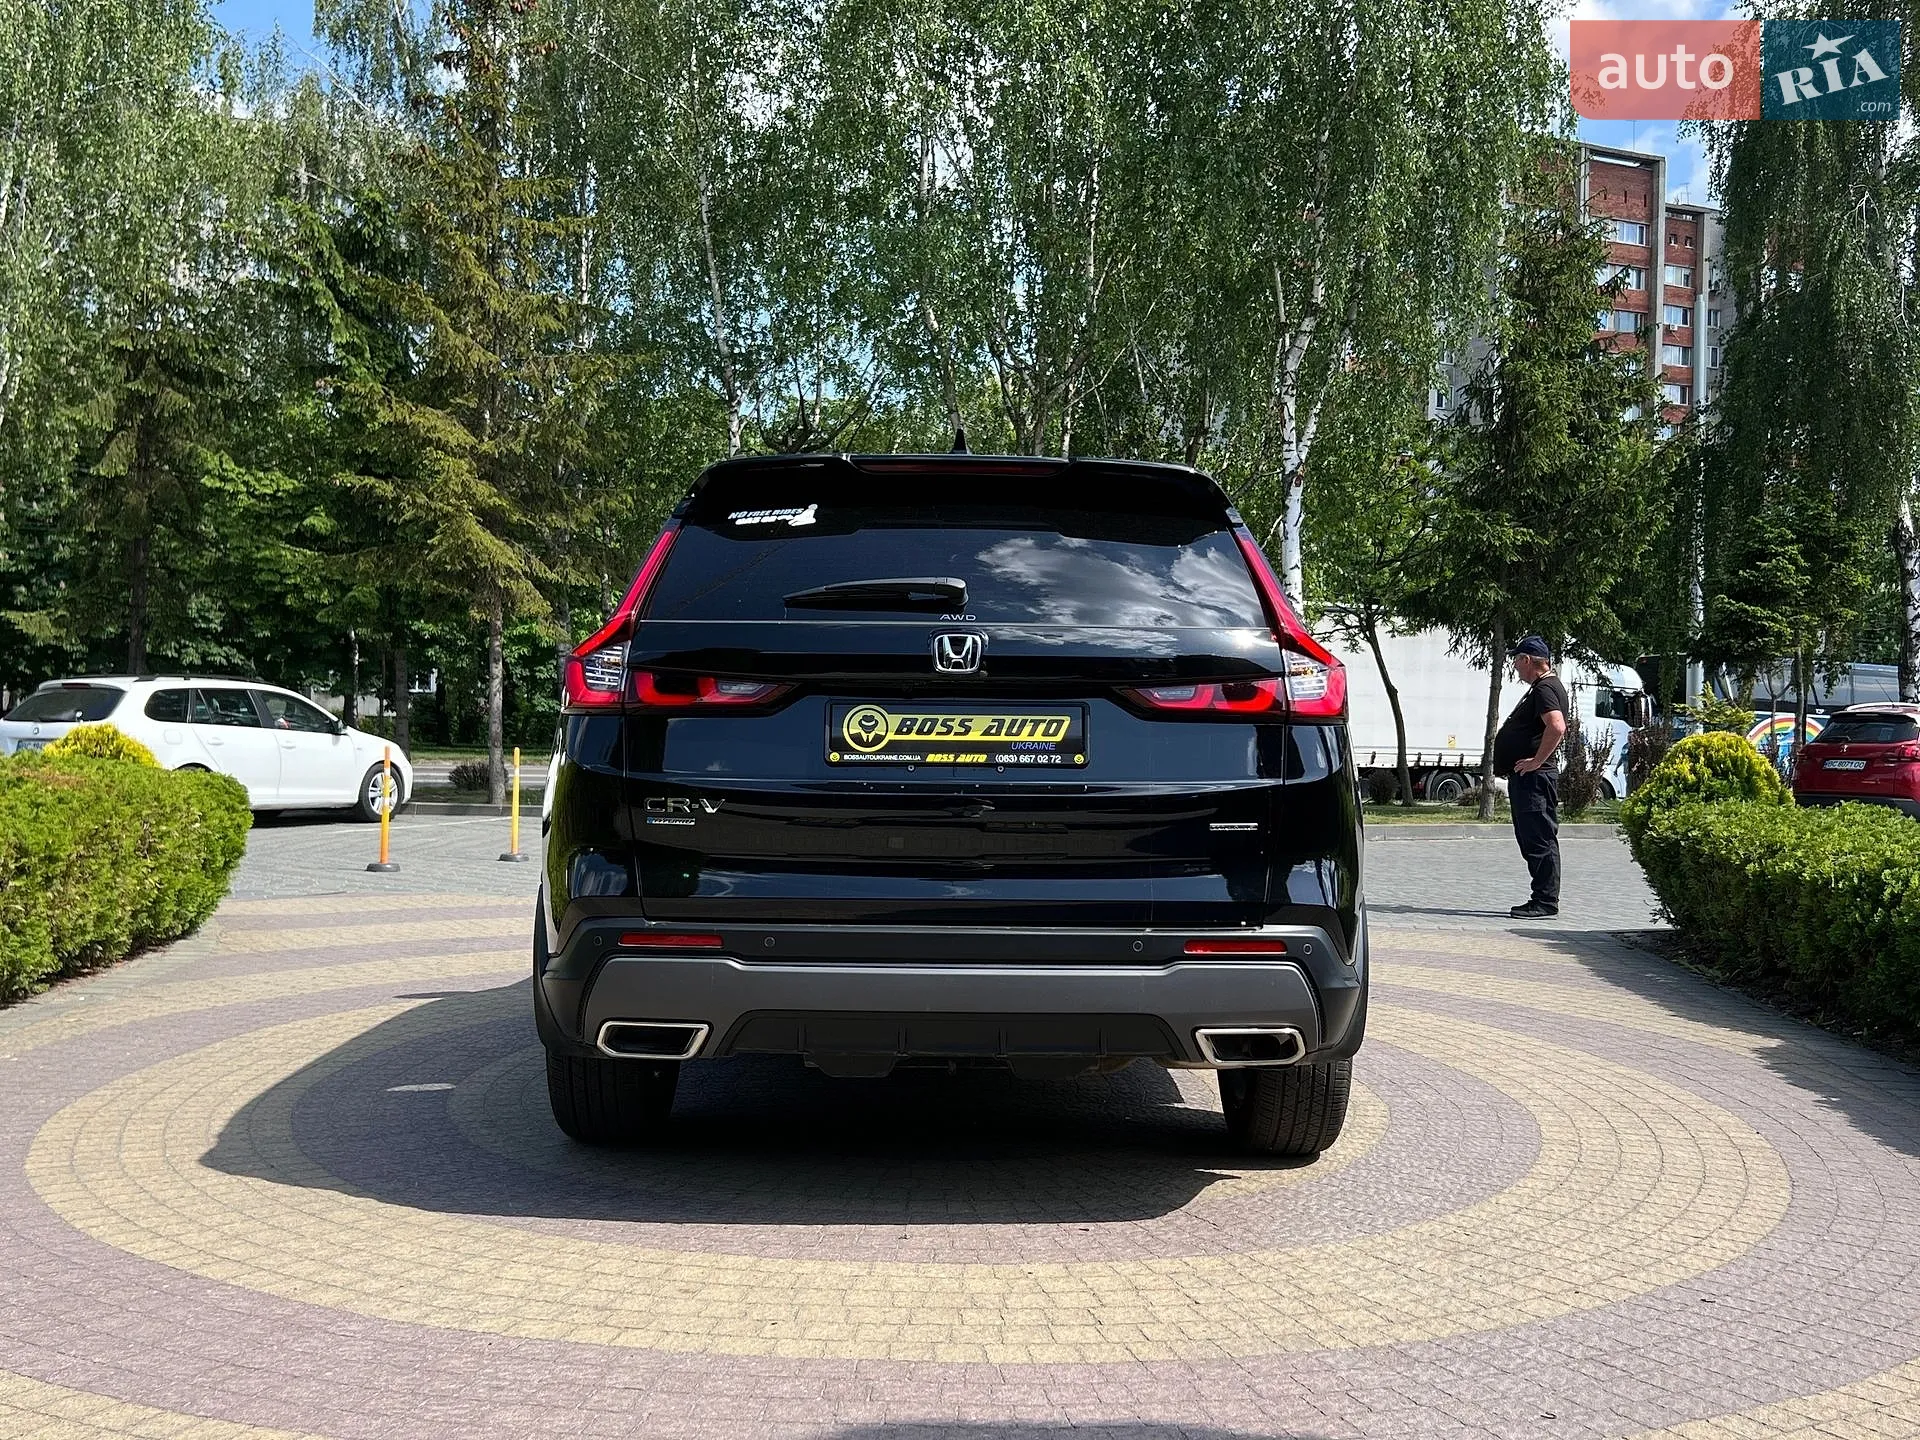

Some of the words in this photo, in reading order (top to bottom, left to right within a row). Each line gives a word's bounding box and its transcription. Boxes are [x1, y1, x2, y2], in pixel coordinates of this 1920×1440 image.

[894, 717, 973, 736] BOSS
[981, 718, 1065, 737] AUTO
[1011, 741, 1057, 751] UKRAINE
[925, 753, 956, 763] BOSS
[955, 753, 988, 763] AUTO
[1018, 754, 1036, 763] 667
[1036, 754, 1048, 763] 02
[1049, 754, 1062, 764] 72
[644, 797, 726, 813] CR-V
